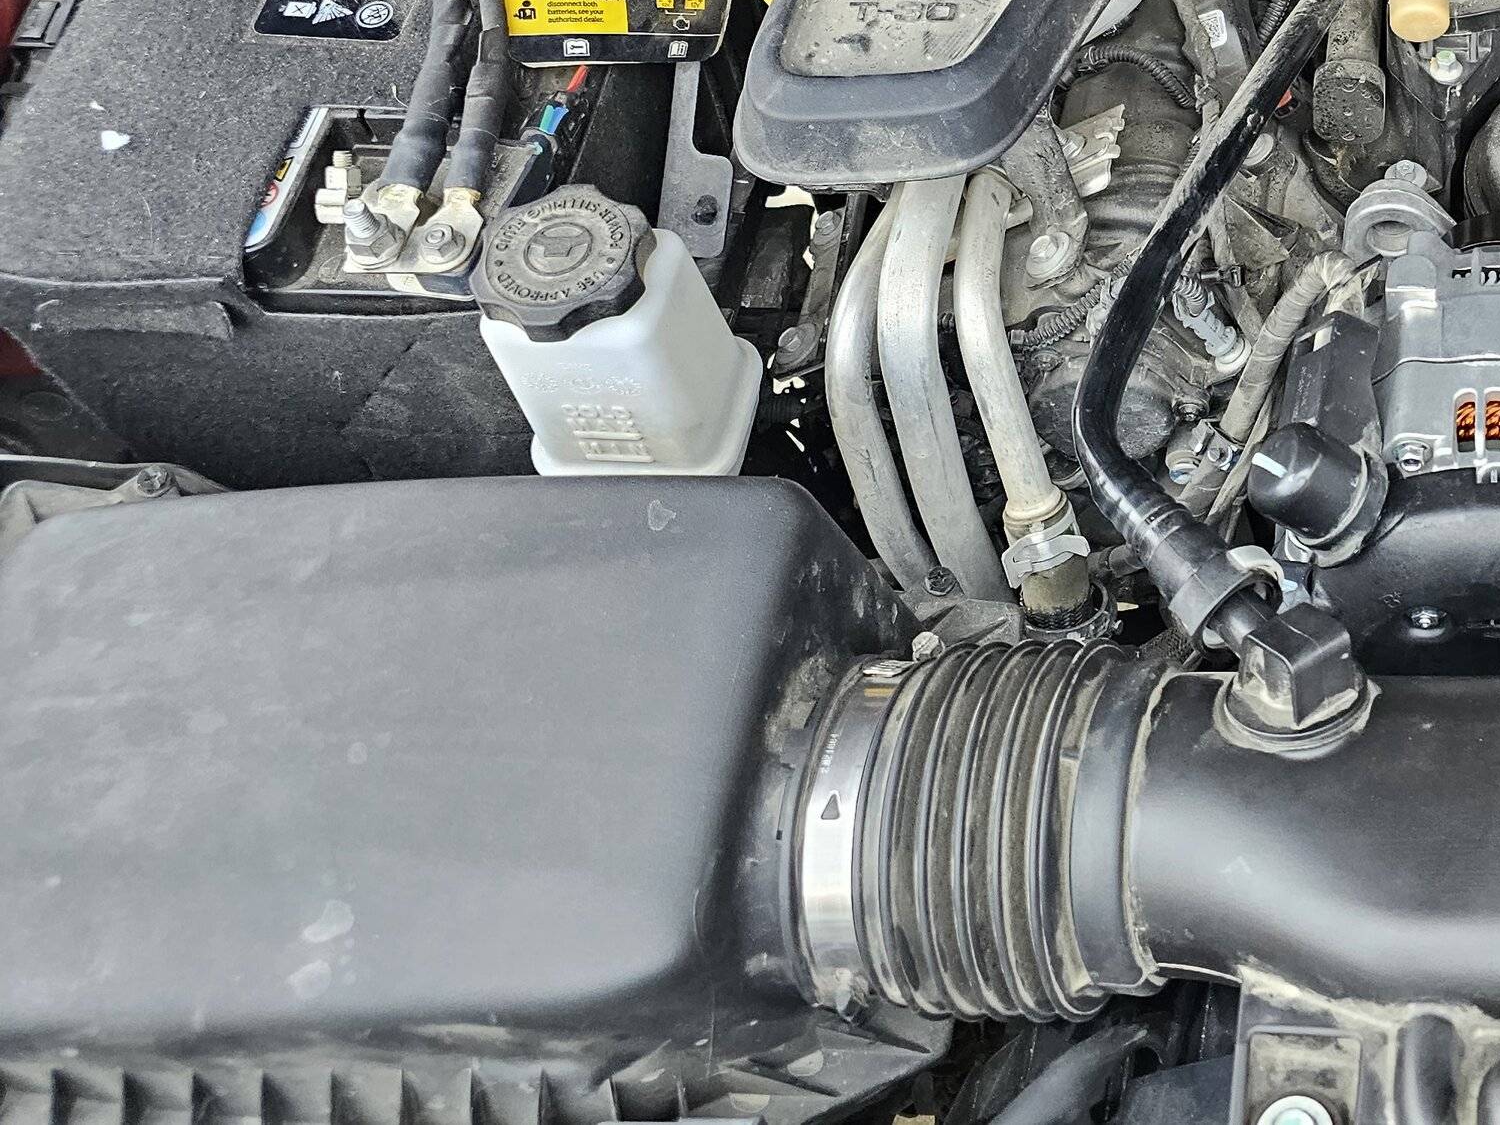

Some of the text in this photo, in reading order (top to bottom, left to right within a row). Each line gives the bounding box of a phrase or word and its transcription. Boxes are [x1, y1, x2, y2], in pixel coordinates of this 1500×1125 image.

[849, 1, 960, 22] T-30
[495, 197, 625, 252] POWER STEERING FLUID
[497, 269, 605, 302] USE APPROVED
[561, 404, 633, 420] COLD
[566, 418, 641, 432] MAX
[579, 441, 650, 456] MIN
